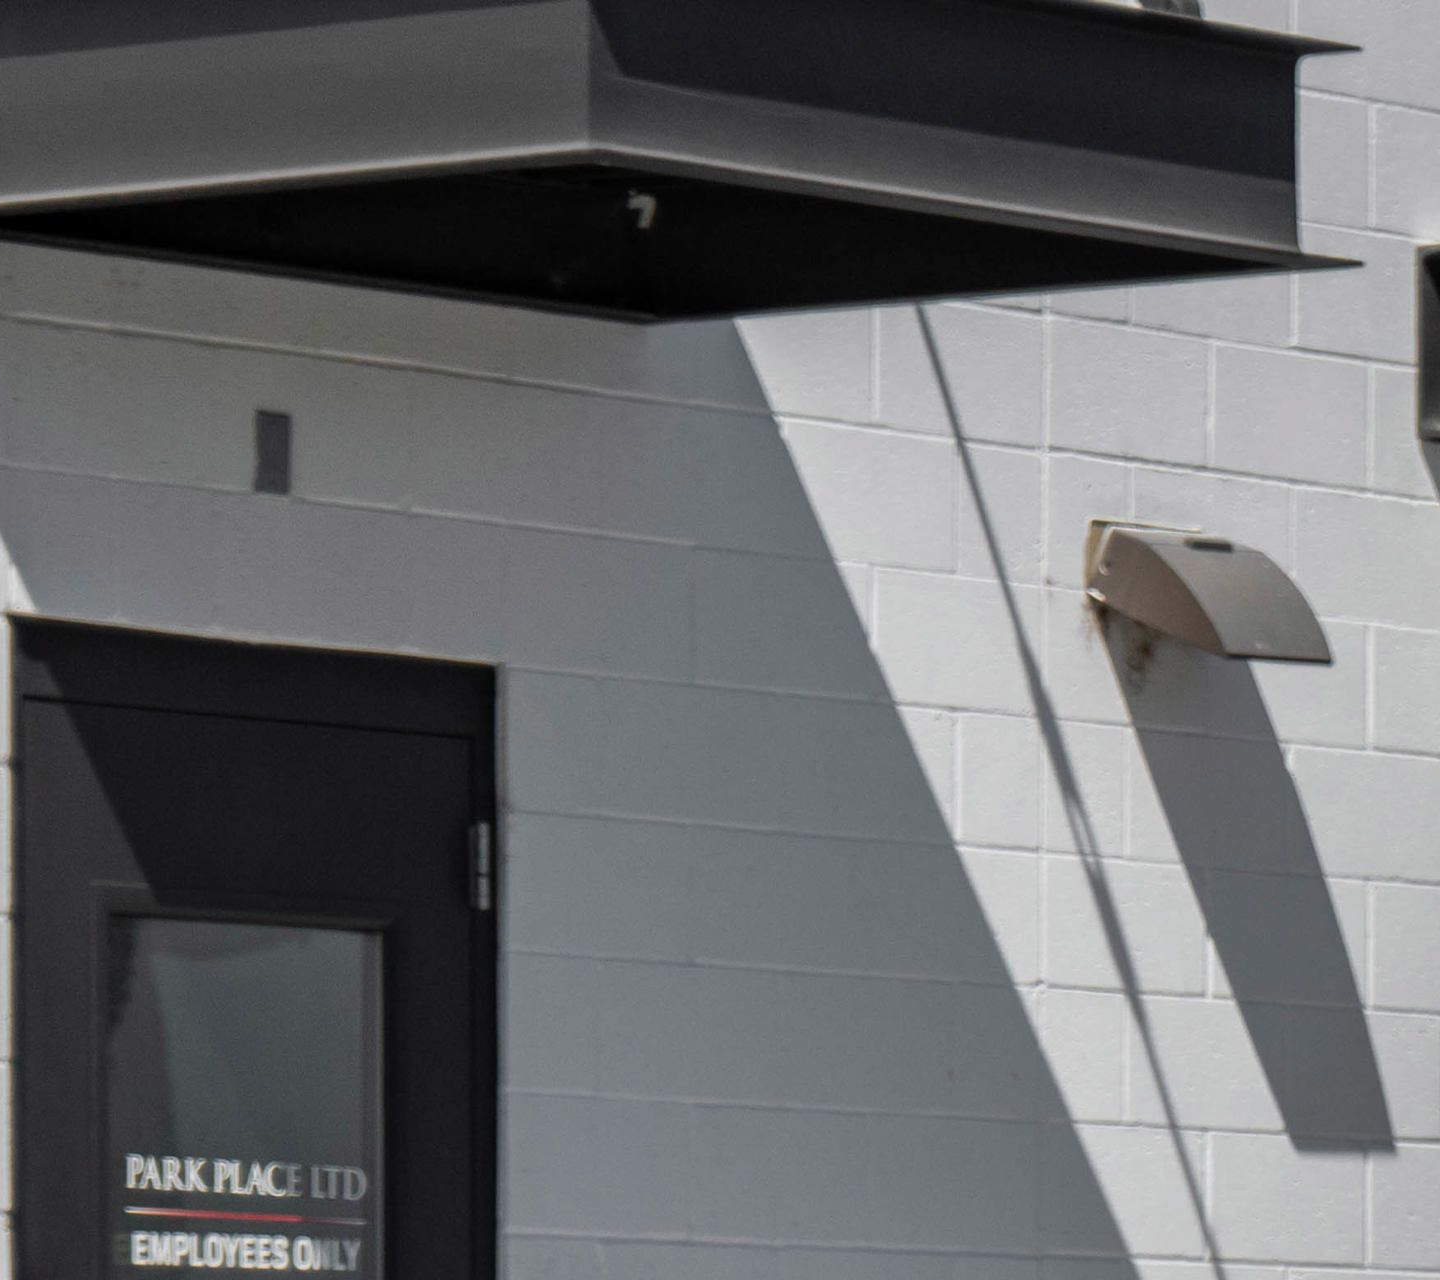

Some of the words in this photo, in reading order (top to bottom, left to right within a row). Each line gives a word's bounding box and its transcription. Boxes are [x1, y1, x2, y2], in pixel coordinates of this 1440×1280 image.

[125, 1153, 208, 1194] PARK
[213, 1158, 303, 1199] PLACE
[310, 1165, 368, 1202] LTD
[131, 1230, 289, 1271] EMPLOYEES
[293, 1235, 362, 1273] ONLY
